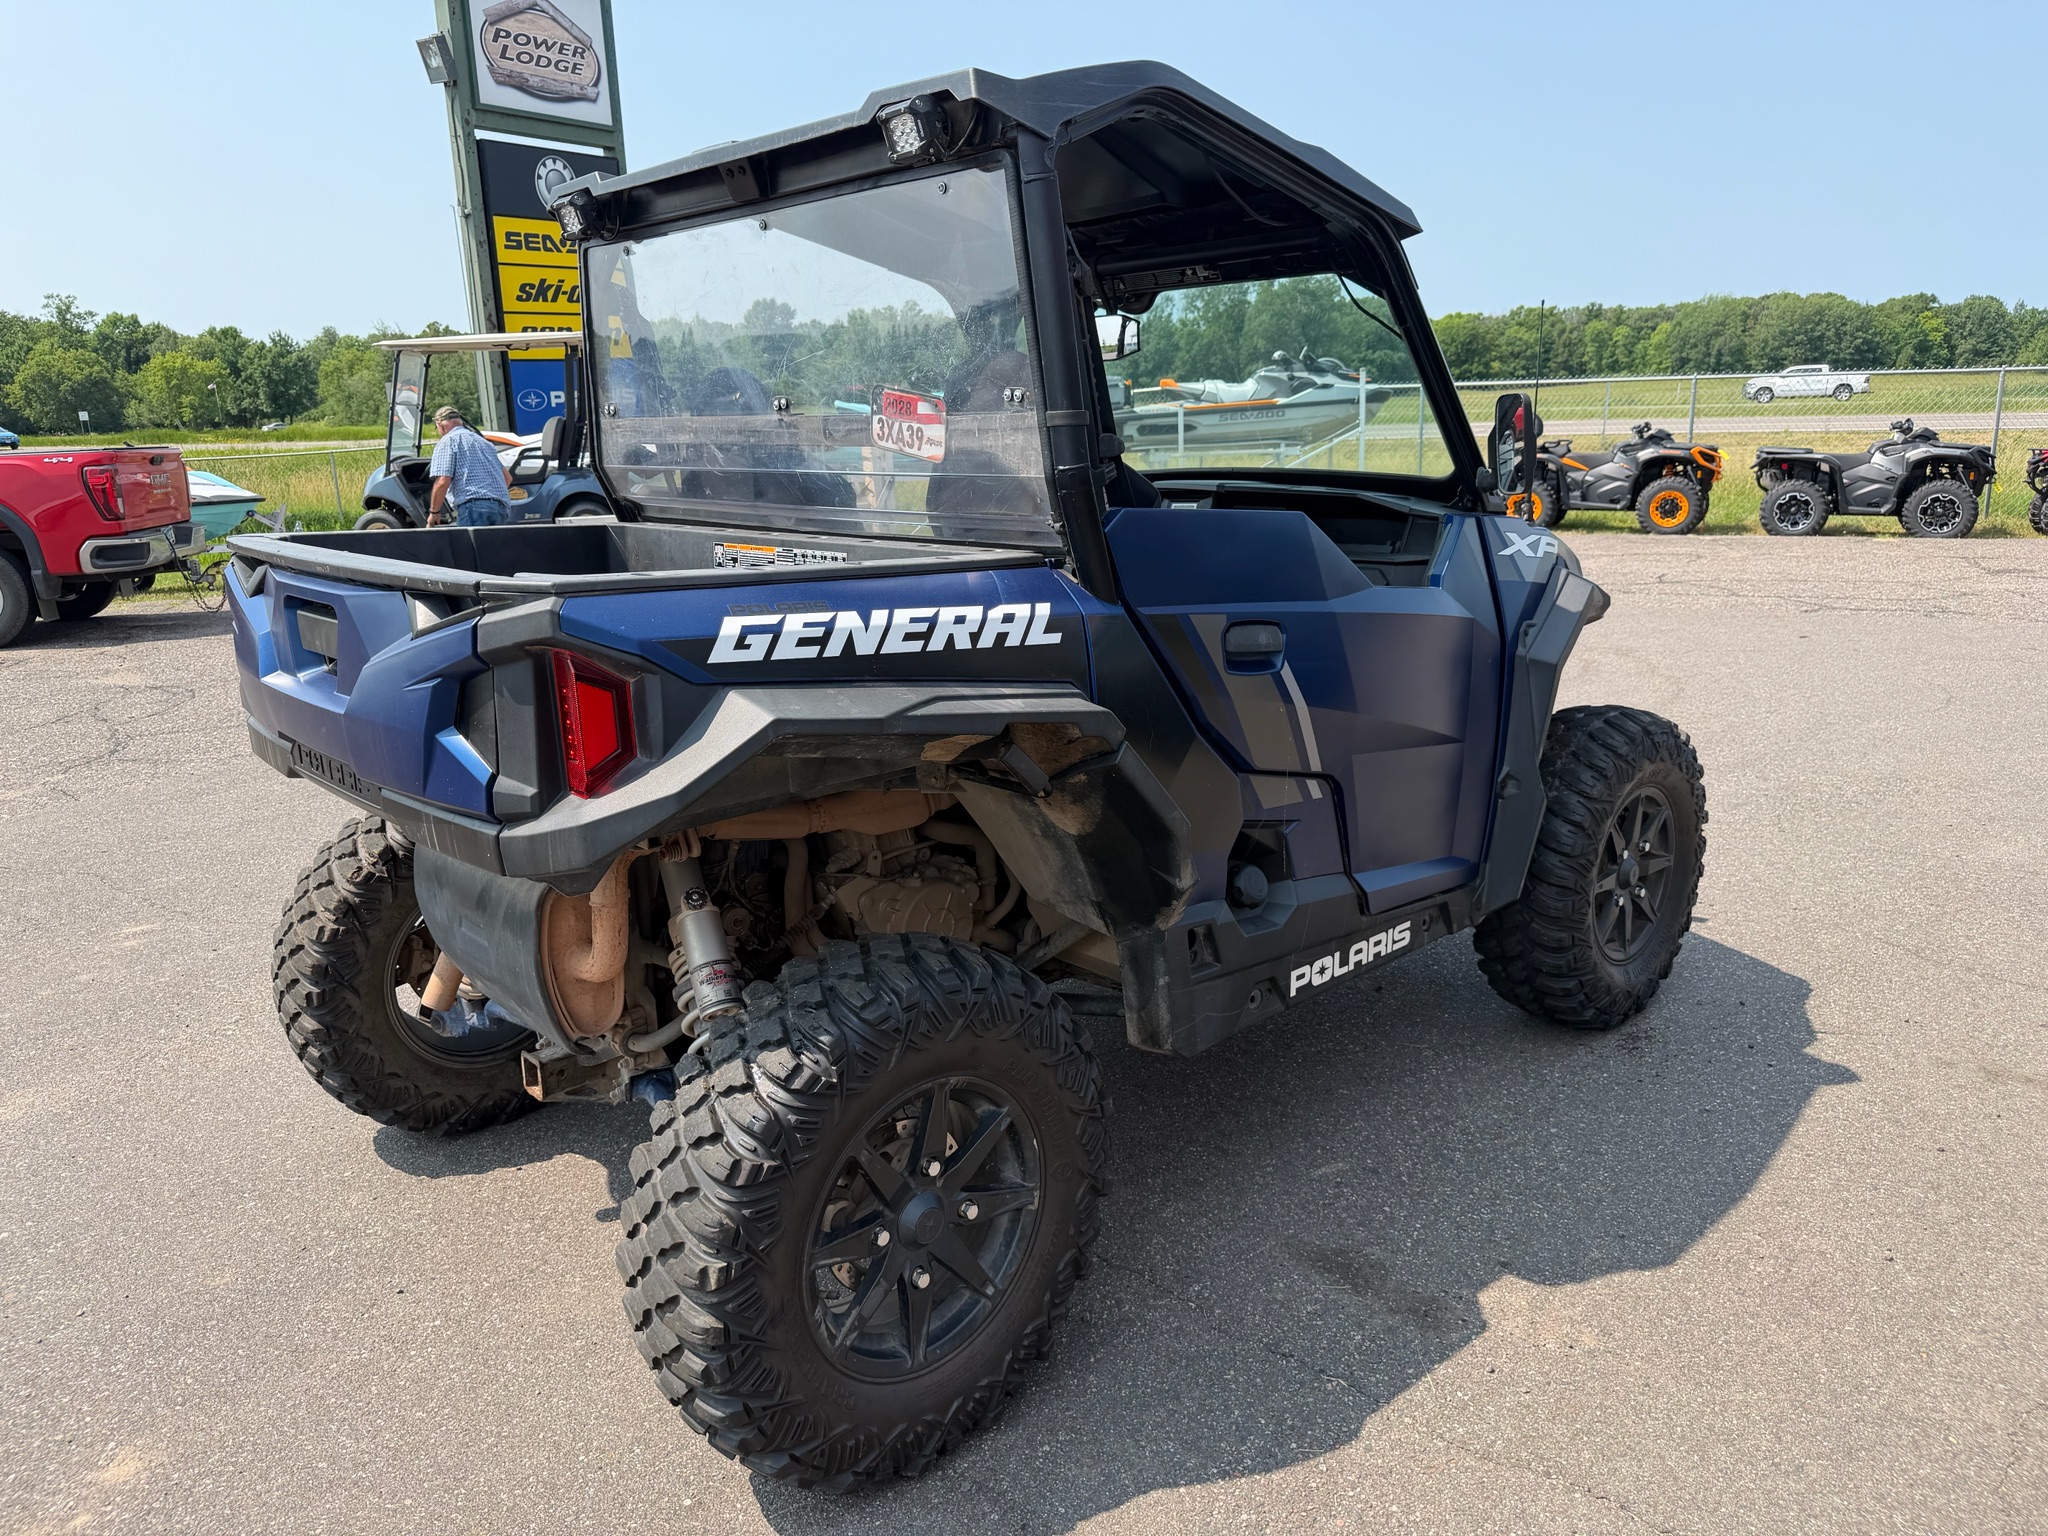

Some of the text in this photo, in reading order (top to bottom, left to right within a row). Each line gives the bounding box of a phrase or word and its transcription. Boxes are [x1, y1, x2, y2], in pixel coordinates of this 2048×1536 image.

[491, 27, 587, 60] POWER
[498, 44, 584, 76] LODGE
[876, 416, 924, 452] 3XA39
[1497, 531, 1558, 558] XP
[727, 600, 832, 616] POLARIS
[707, 602, 1062, 664] GENERAL
[1289, 920, 1411, 998] POLARIS
